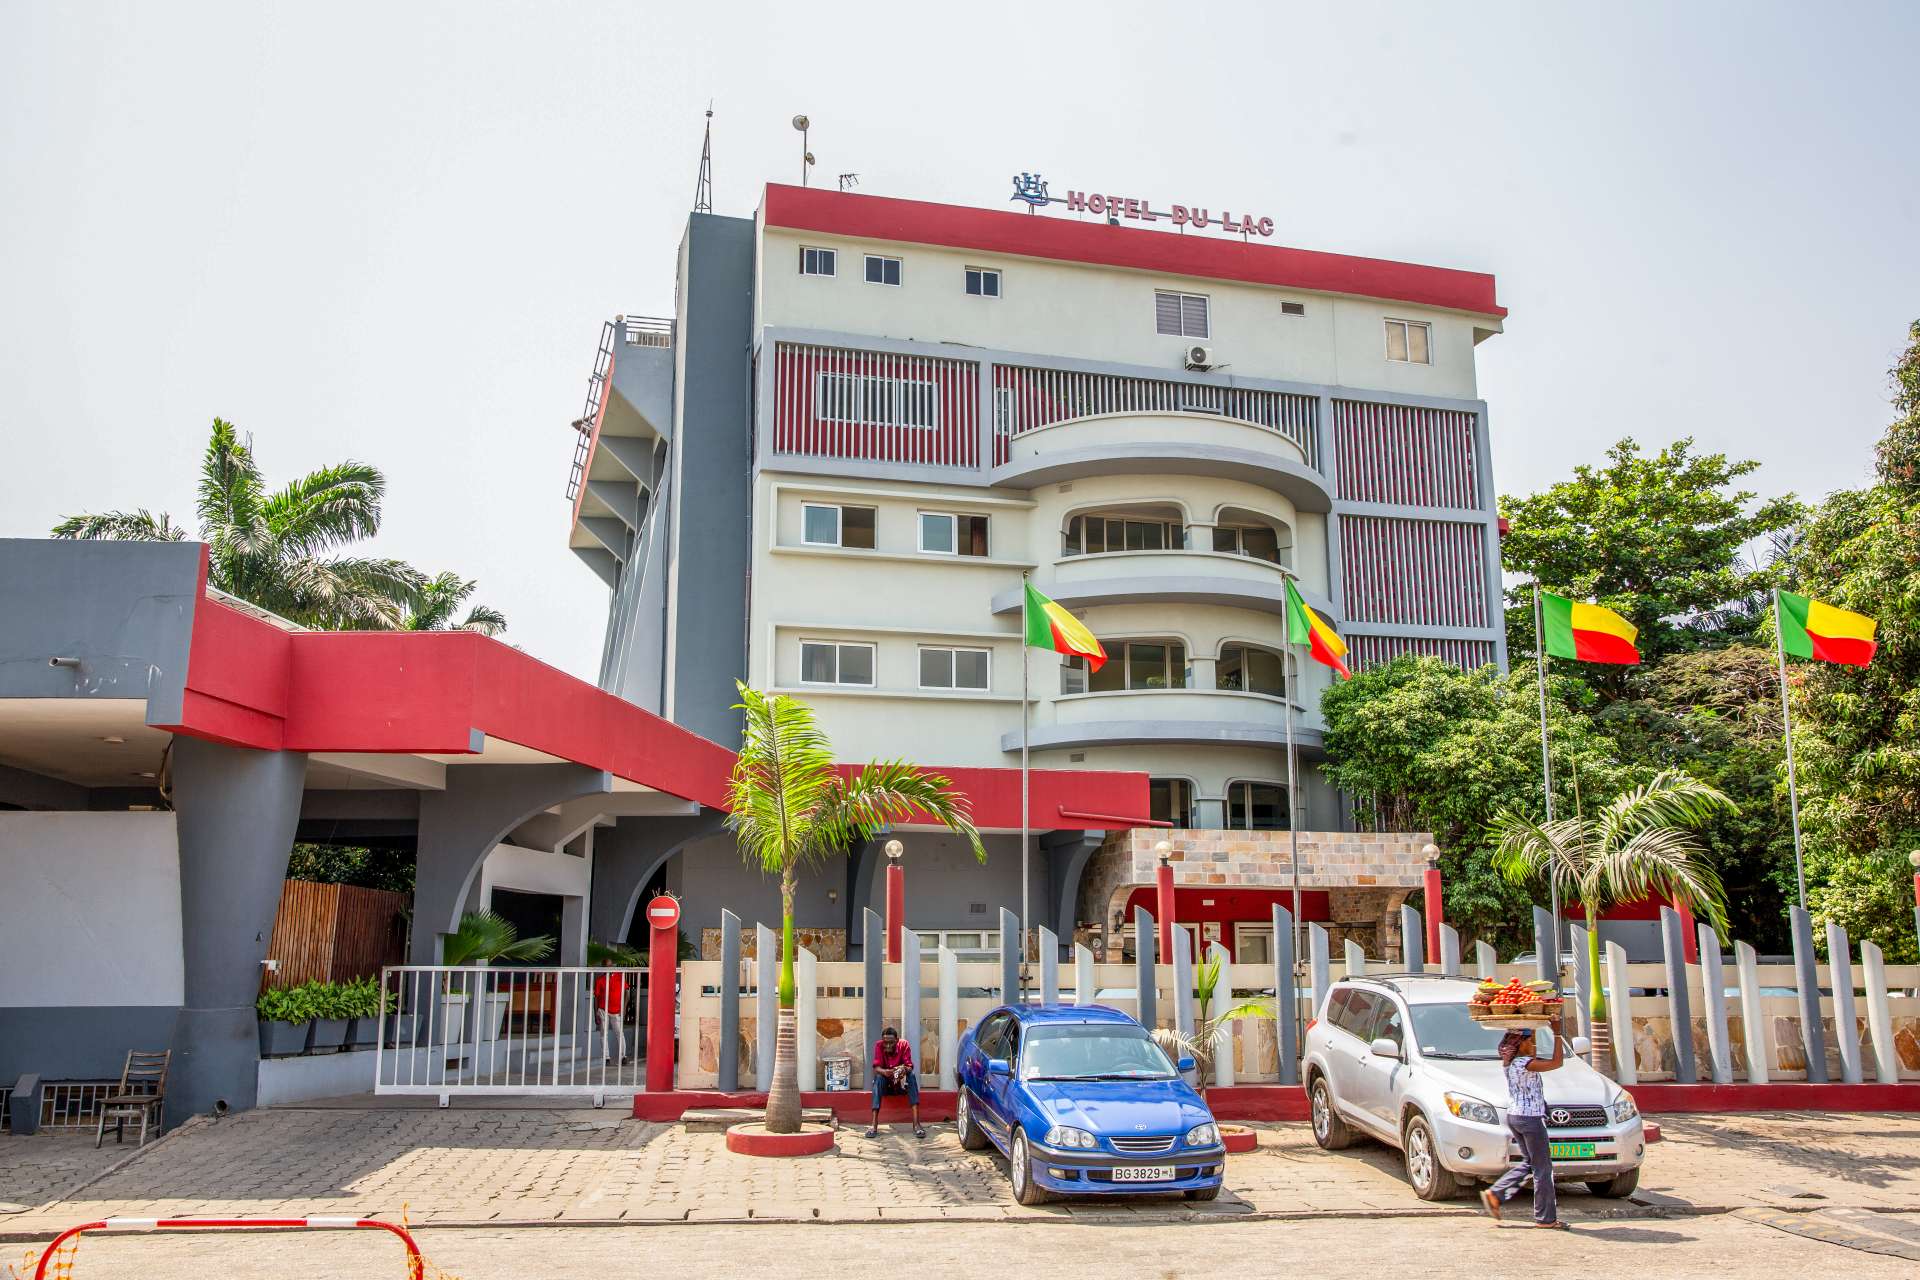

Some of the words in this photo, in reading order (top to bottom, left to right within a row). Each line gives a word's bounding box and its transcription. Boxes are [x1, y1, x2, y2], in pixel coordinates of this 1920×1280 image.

[1067, 190, 1157, 221] HOTEL
[1171, 204, 1208, 228] DU
[1222, 211, 1274, 237] LAC
[1115, 1168, 1131, 1179] BG
[1133, 1168, 1160, 1179] 3829
